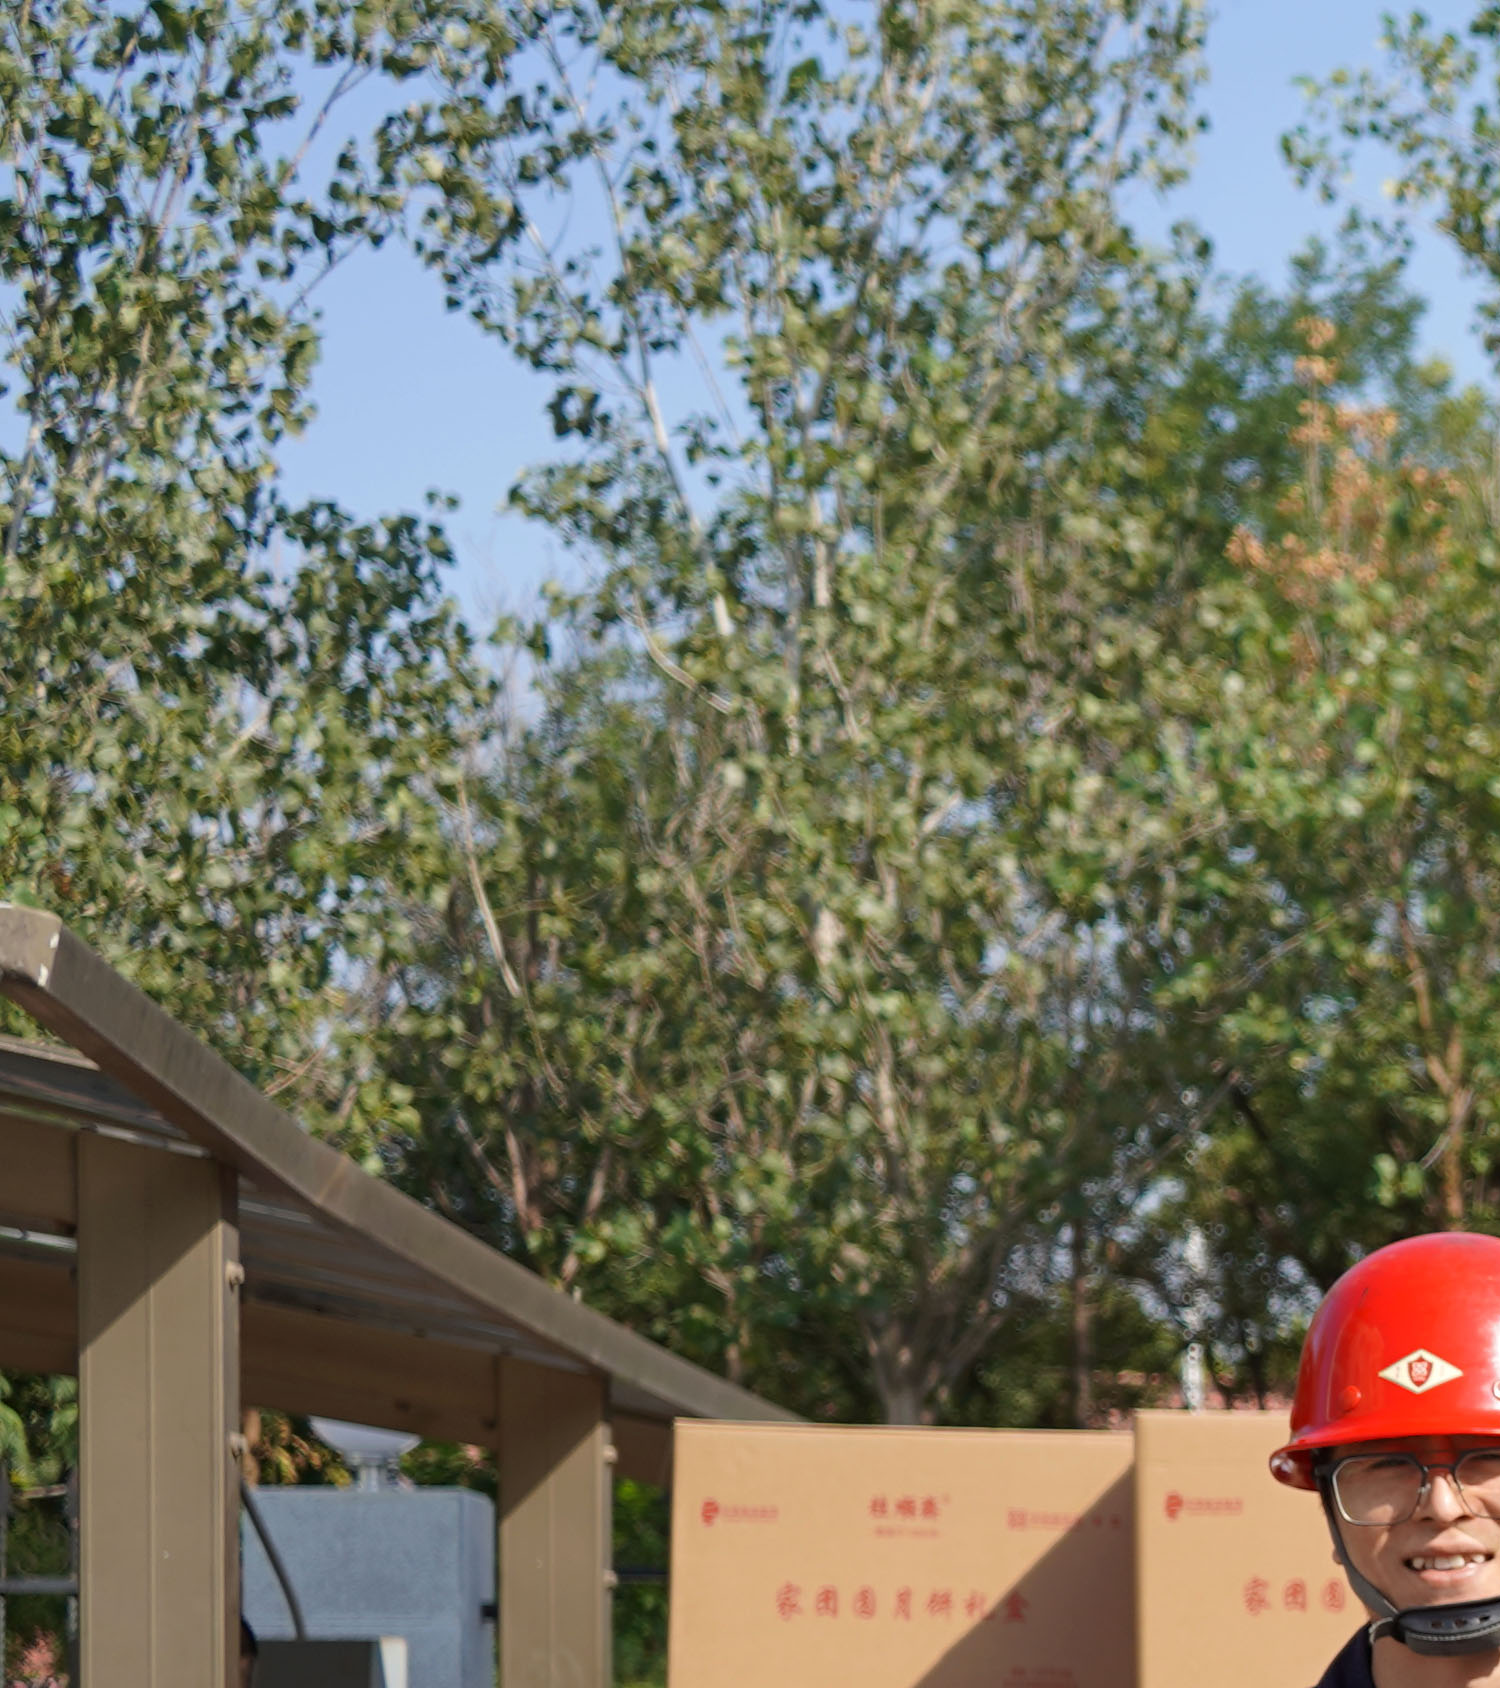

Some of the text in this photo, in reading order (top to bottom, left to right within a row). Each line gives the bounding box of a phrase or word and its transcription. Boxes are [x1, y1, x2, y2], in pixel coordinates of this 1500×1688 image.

[776, 1581, 1030, 1622] 家团圆月饼礼盒
